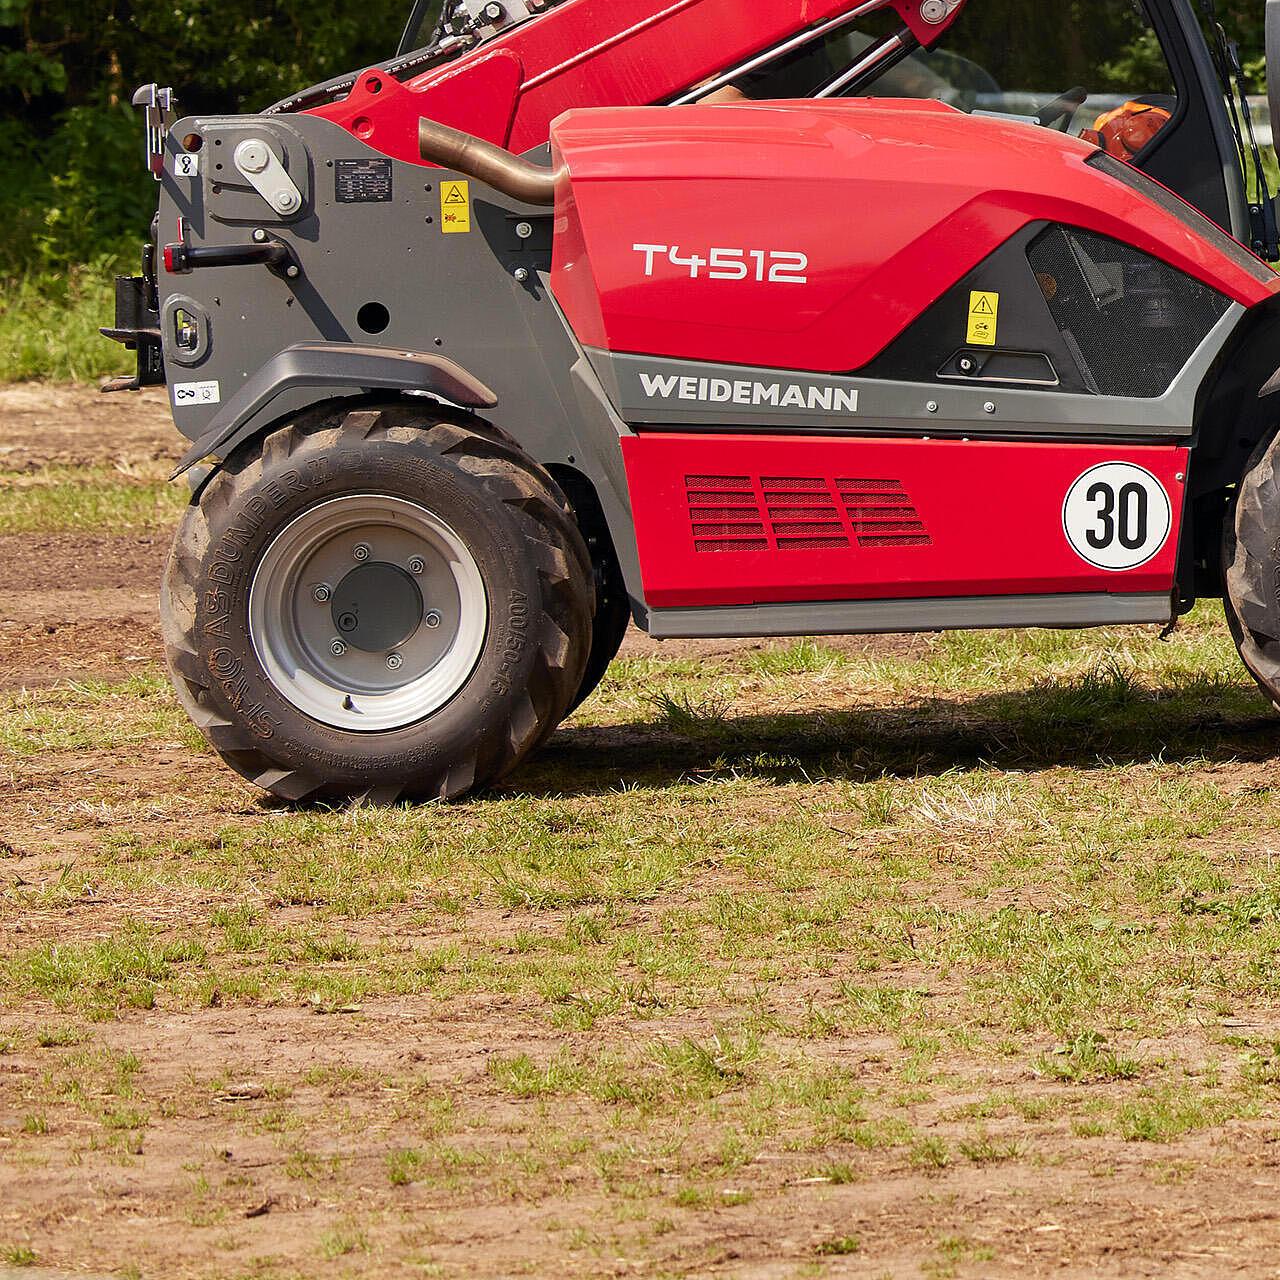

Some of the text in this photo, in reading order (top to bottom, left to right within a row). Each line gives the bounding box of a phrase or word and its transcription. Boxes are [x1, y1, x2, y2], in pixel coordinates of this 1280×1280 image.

[632, 244, 808, 284] T4512
[639, 373, 858, 411] WEIDEMANN
[208, 470, 309, 584] DUMPER
[1086, 482, 1147, 549] 30
